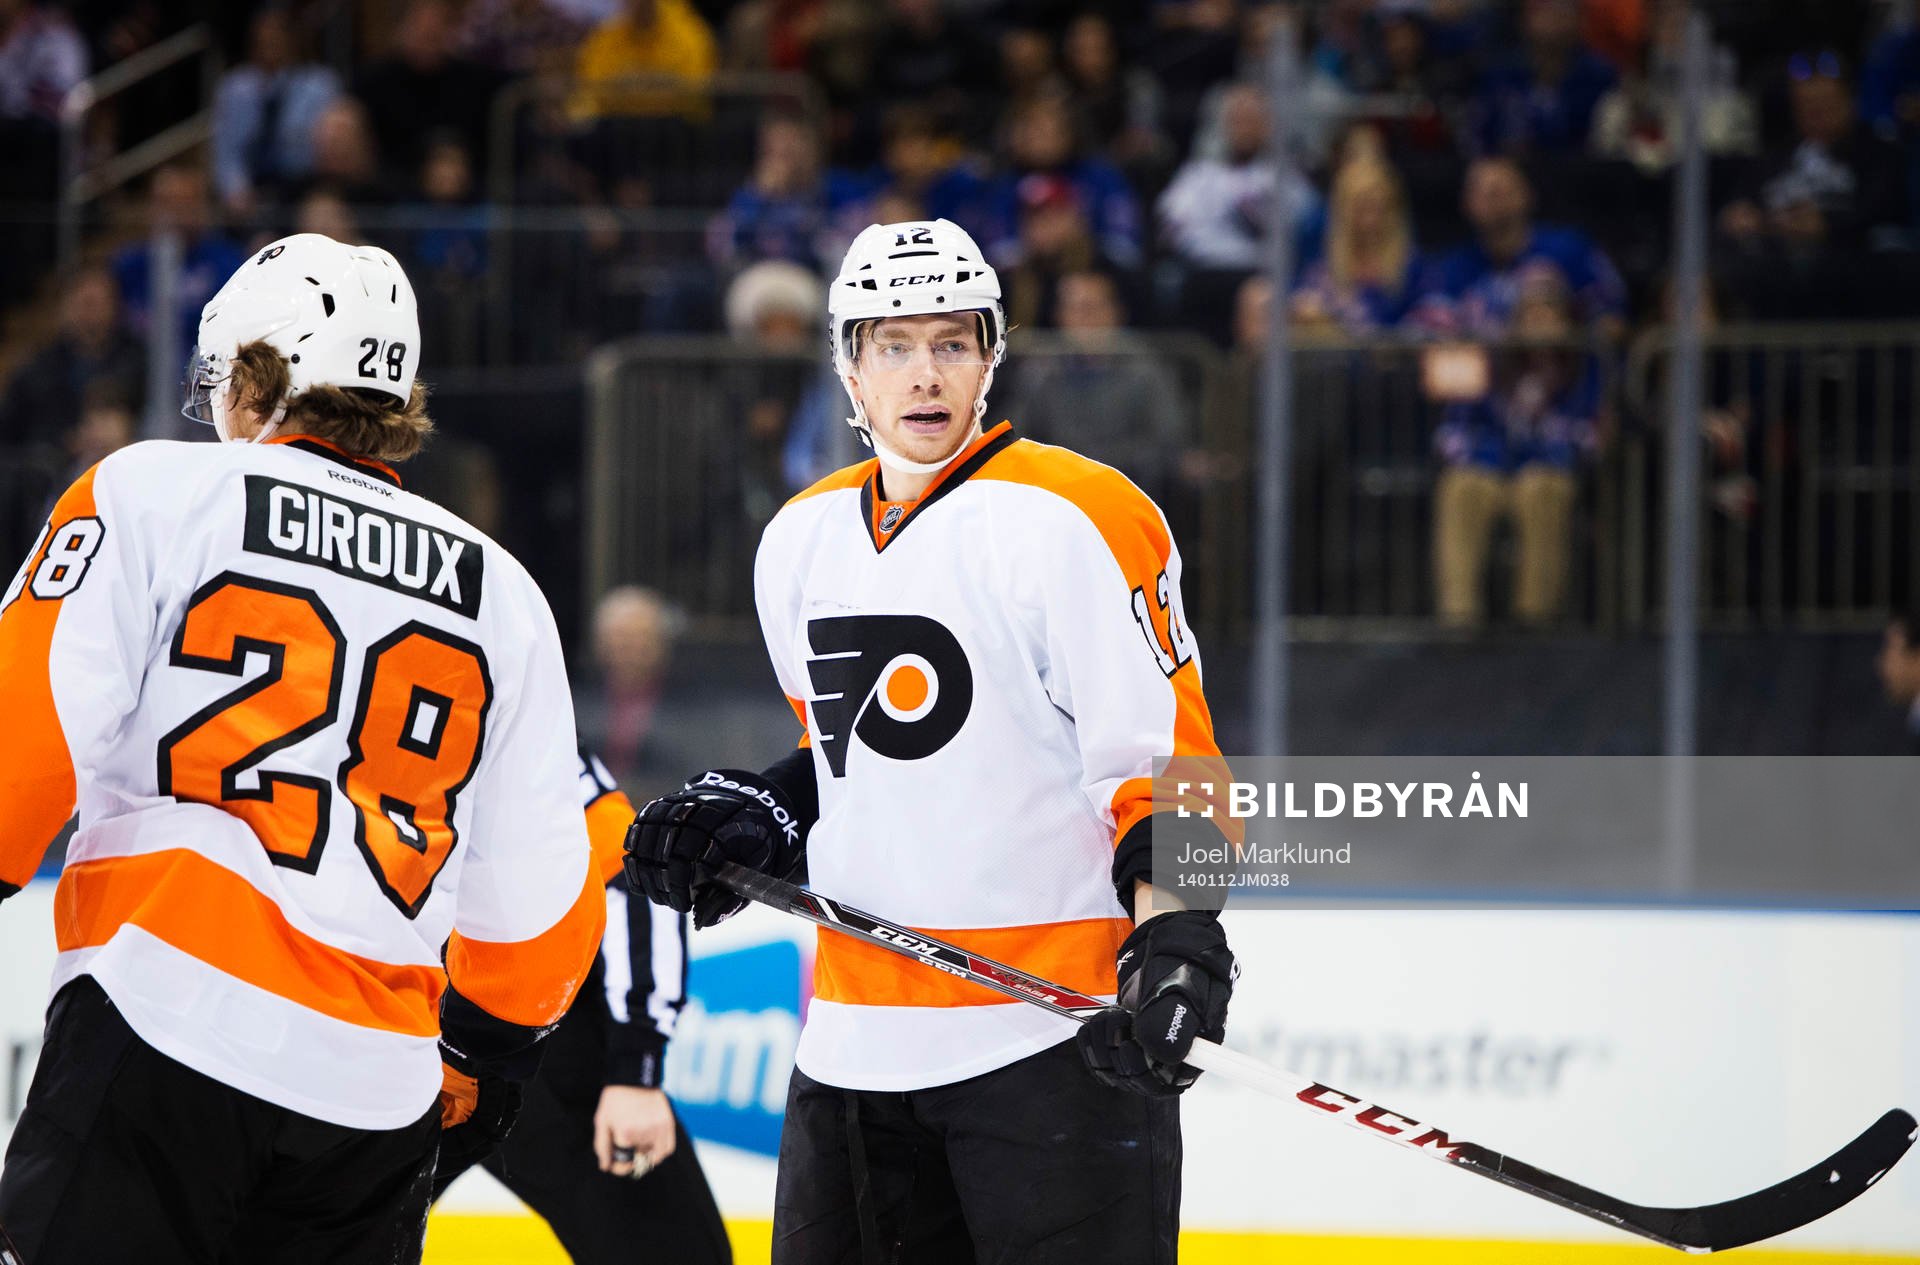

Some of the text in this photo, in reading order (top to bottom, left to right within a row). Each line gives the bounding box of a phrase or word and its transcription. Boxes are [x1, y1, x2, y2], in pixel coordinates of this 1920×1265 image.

[895, 227, 934, 247] 12
[889, 274, 946, 288] CCM
[358, 337, 407, 382] 28
[327, 469, 395, 500] Reebok
[267, 485, 467, 605] GIROUX
[1131, 568, 1193, 680] 12
[156, 569, 494, 921] 28
[697, 771, 800, 848] Reebok
[870, 925, 941, 956] CCM
[918, 954, 968, 979] CCM
[1165, 1003, 1188, 1044] Reebok
[1296, 1081, 1469, 1160] CCM
